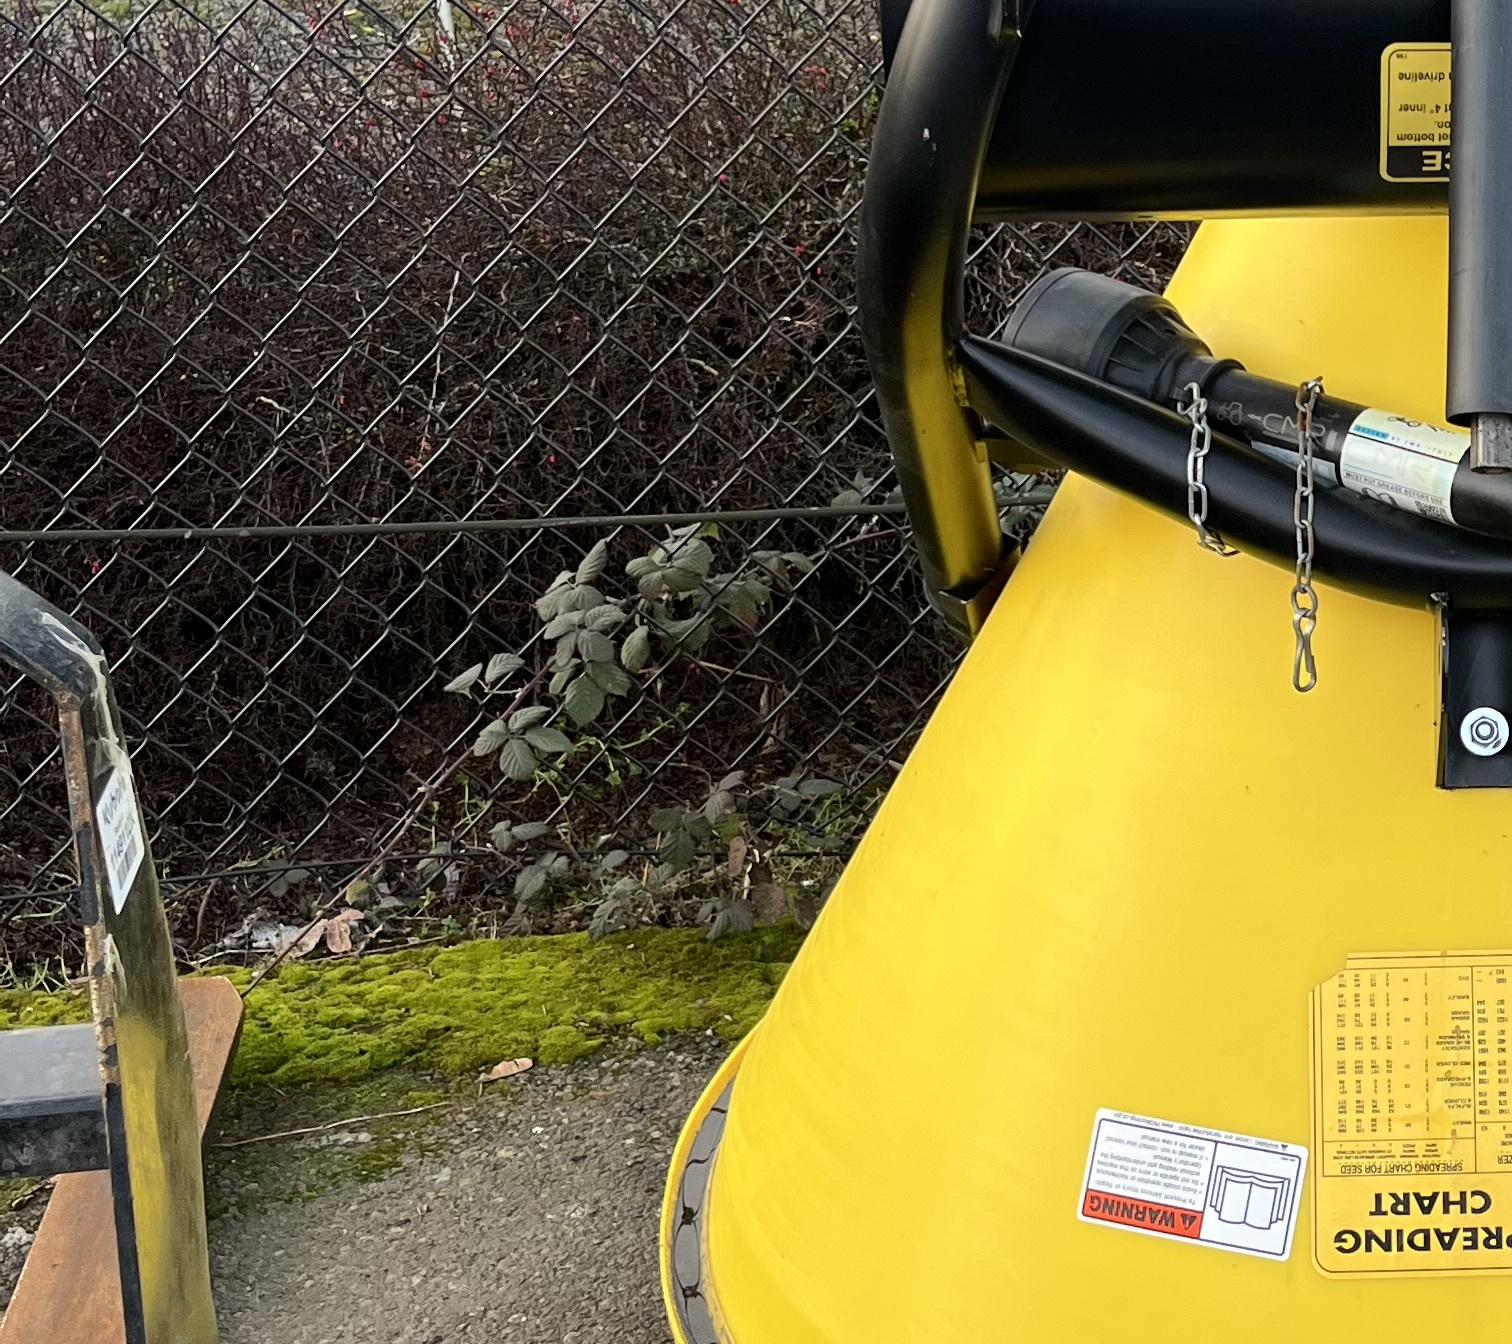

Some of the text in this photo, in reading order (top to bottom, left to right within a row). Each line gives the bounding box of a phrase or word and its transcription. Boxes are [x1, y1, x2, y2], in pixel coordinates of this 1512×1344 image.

[1398, 72, 1445, 83] driveline
[1398, 103, 1426, 113] inner
[1397, 133, 1434, 141] bottom
[1340, 1162, 1463, 1174] SPREADING CHART FOR SEED
[1369, 1190, 1492, 1216] CHART
[1089, 1195, 1175, 1228] WARNING
